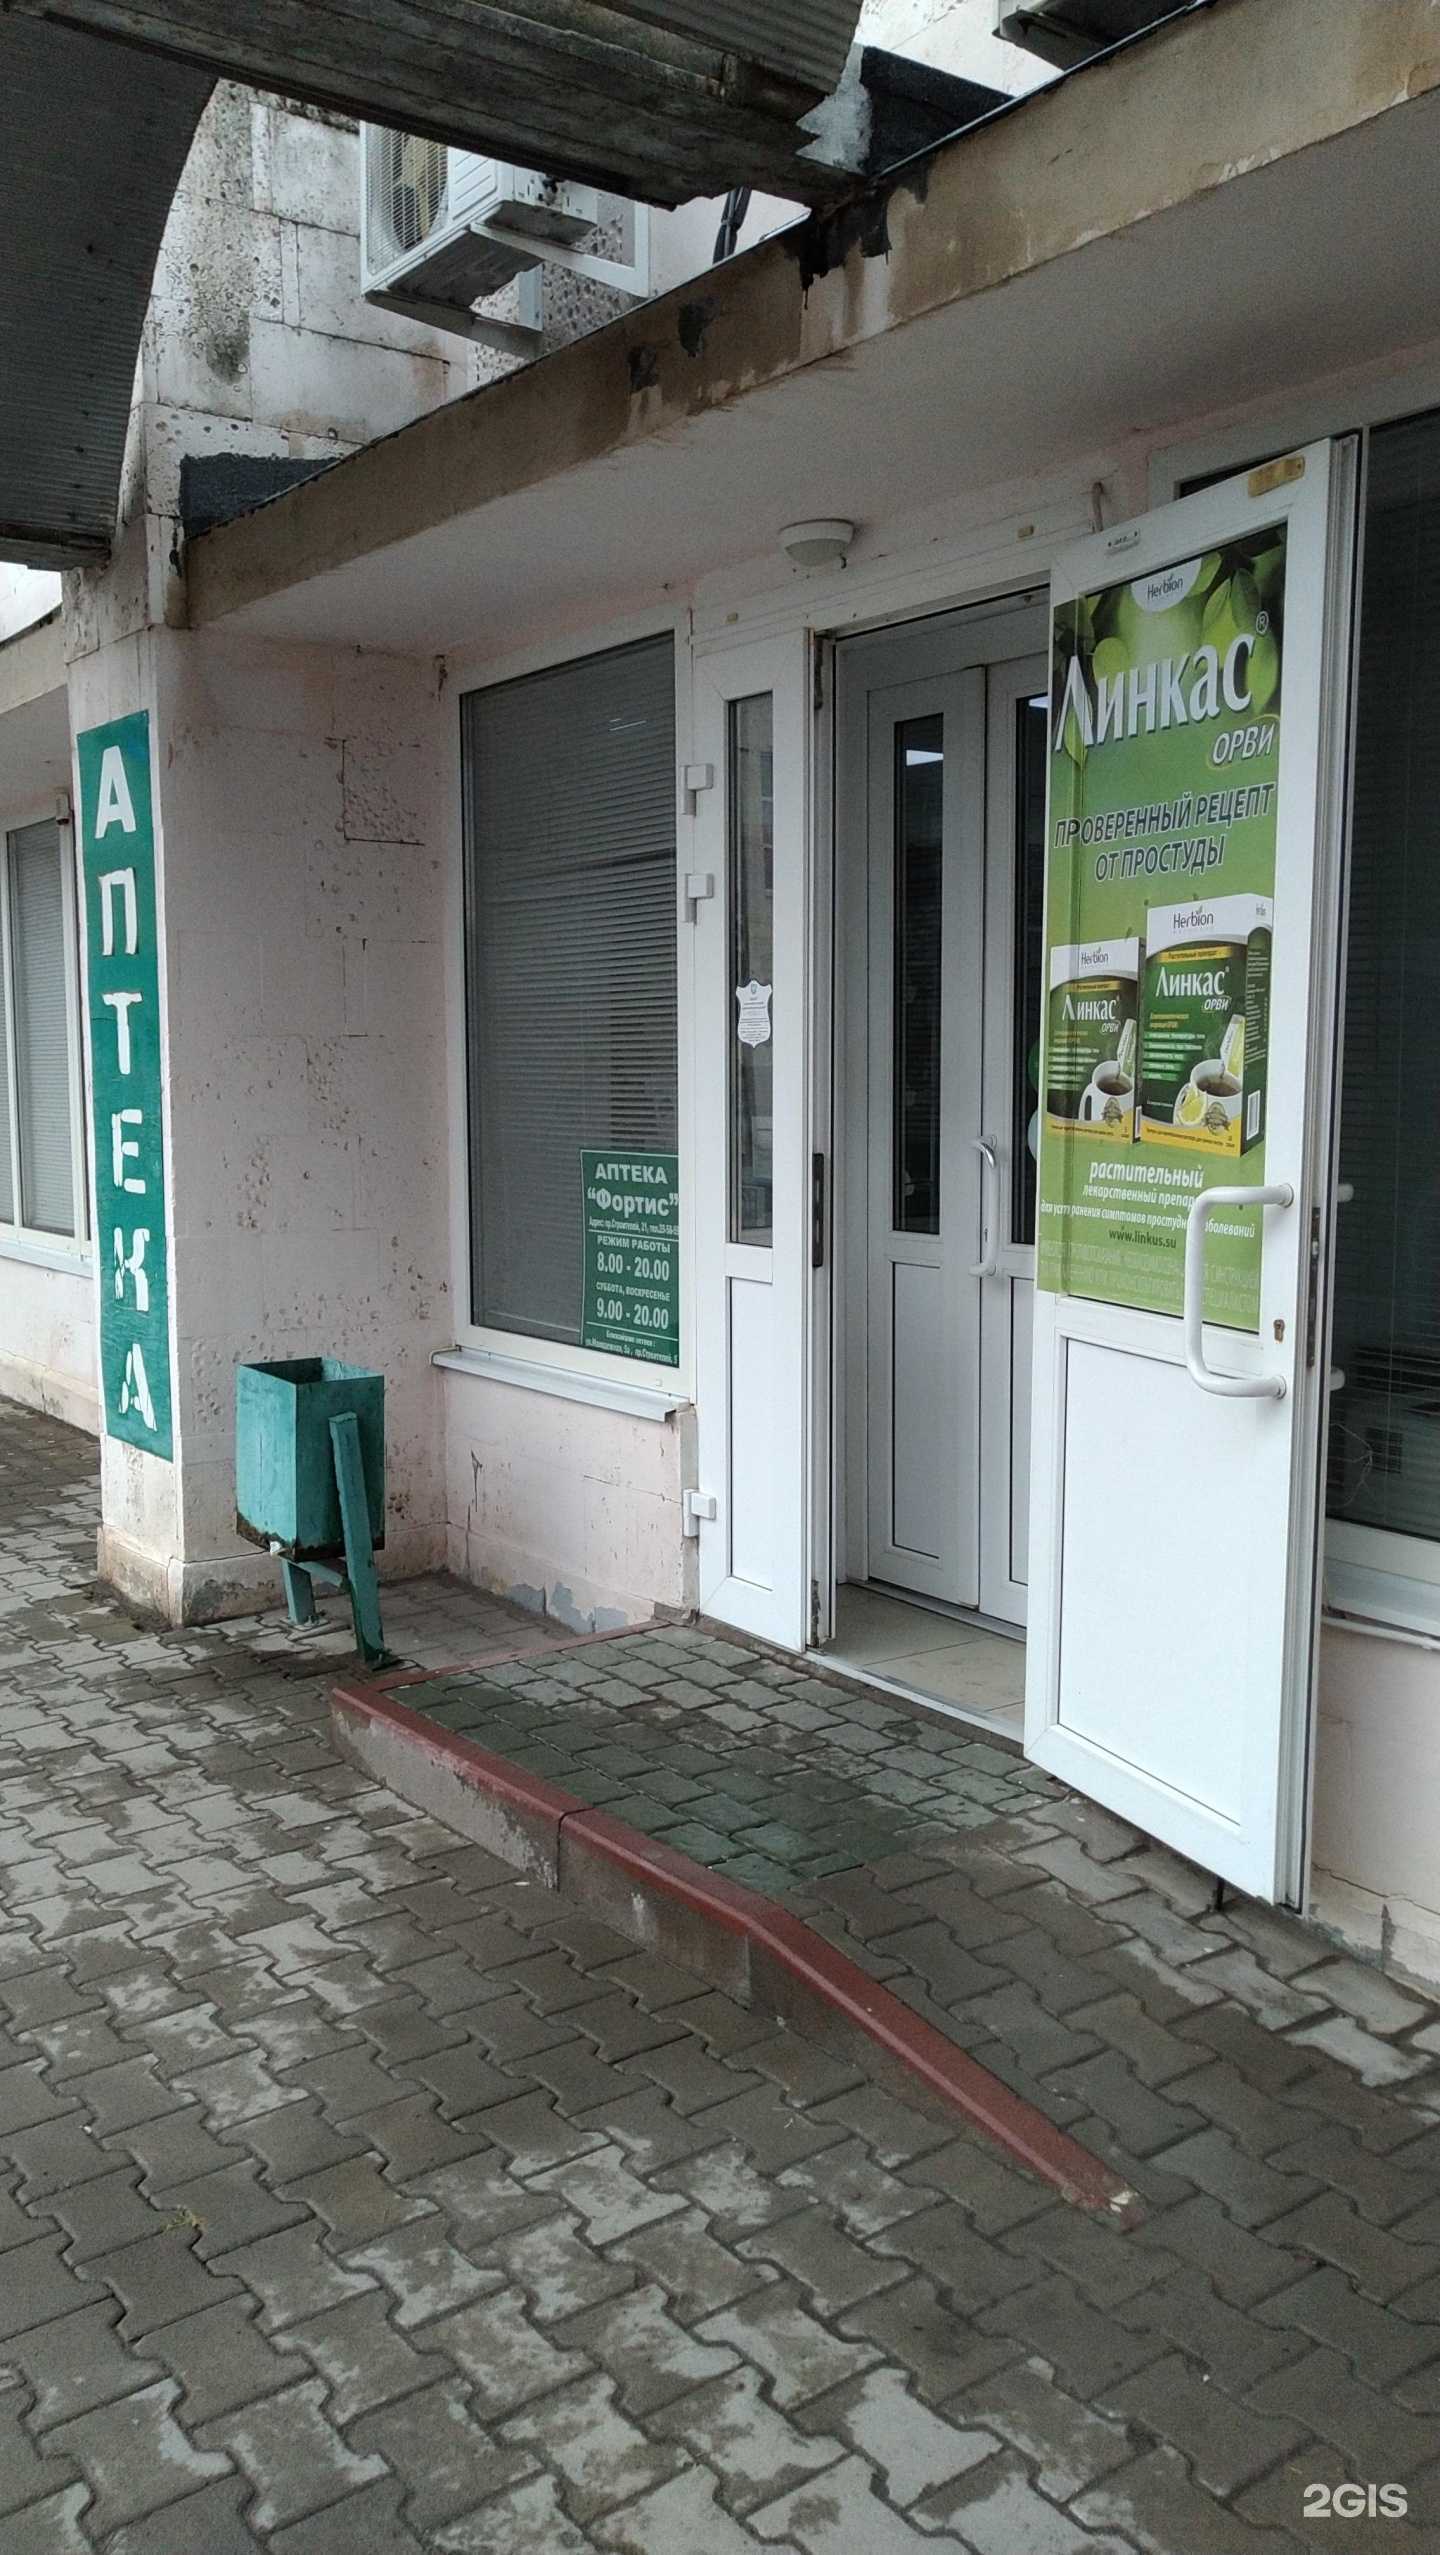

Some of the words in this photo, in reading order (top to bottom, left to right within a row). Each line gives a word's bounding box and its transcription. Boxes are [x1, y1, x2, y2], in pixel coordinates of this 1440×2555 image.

[1147, 575, 1184, 600] Herbion
[1211, 723, 1275, 766] ОРВИ
[1054, 794, 1194, 848] ПРОВЕРЕННЫЙ
[1195, 784, 1276, 827] РЕЦЕПТ
[1096, 852, 1119, 881] ОТ
[1120, 836, 1226, 877] ПРОСТУДЫ
[1173, 911, 1214, 929] Herbion
[1203, 998, 1229, 1011] ОРВИ
[95, 745, 158, 1432] АПТЕКА
[595, 1163, 669, 1184] АПТЕКА
[1089, 1162, 1204, 1188] растительный
[1082, 1184, 1157, 1204] лекарственный
[1158, 1190, 1196, 1210] препар
[1101, 1207, 1146, 1224] симптомов
[597, 1235, 630, 1249] РЕЖИМ
[631, 1239, 671, 1253] РАБОТЫ
[1109, 1229, 1177, 1249] www.linkus.su
[597, 1251, 623, 1274] 8.00
[634, 1256, 670, 1281] 20.00
[596, 1297, 623, 1320] 9.00
[633, 1303, 669, 1329] 20.00
